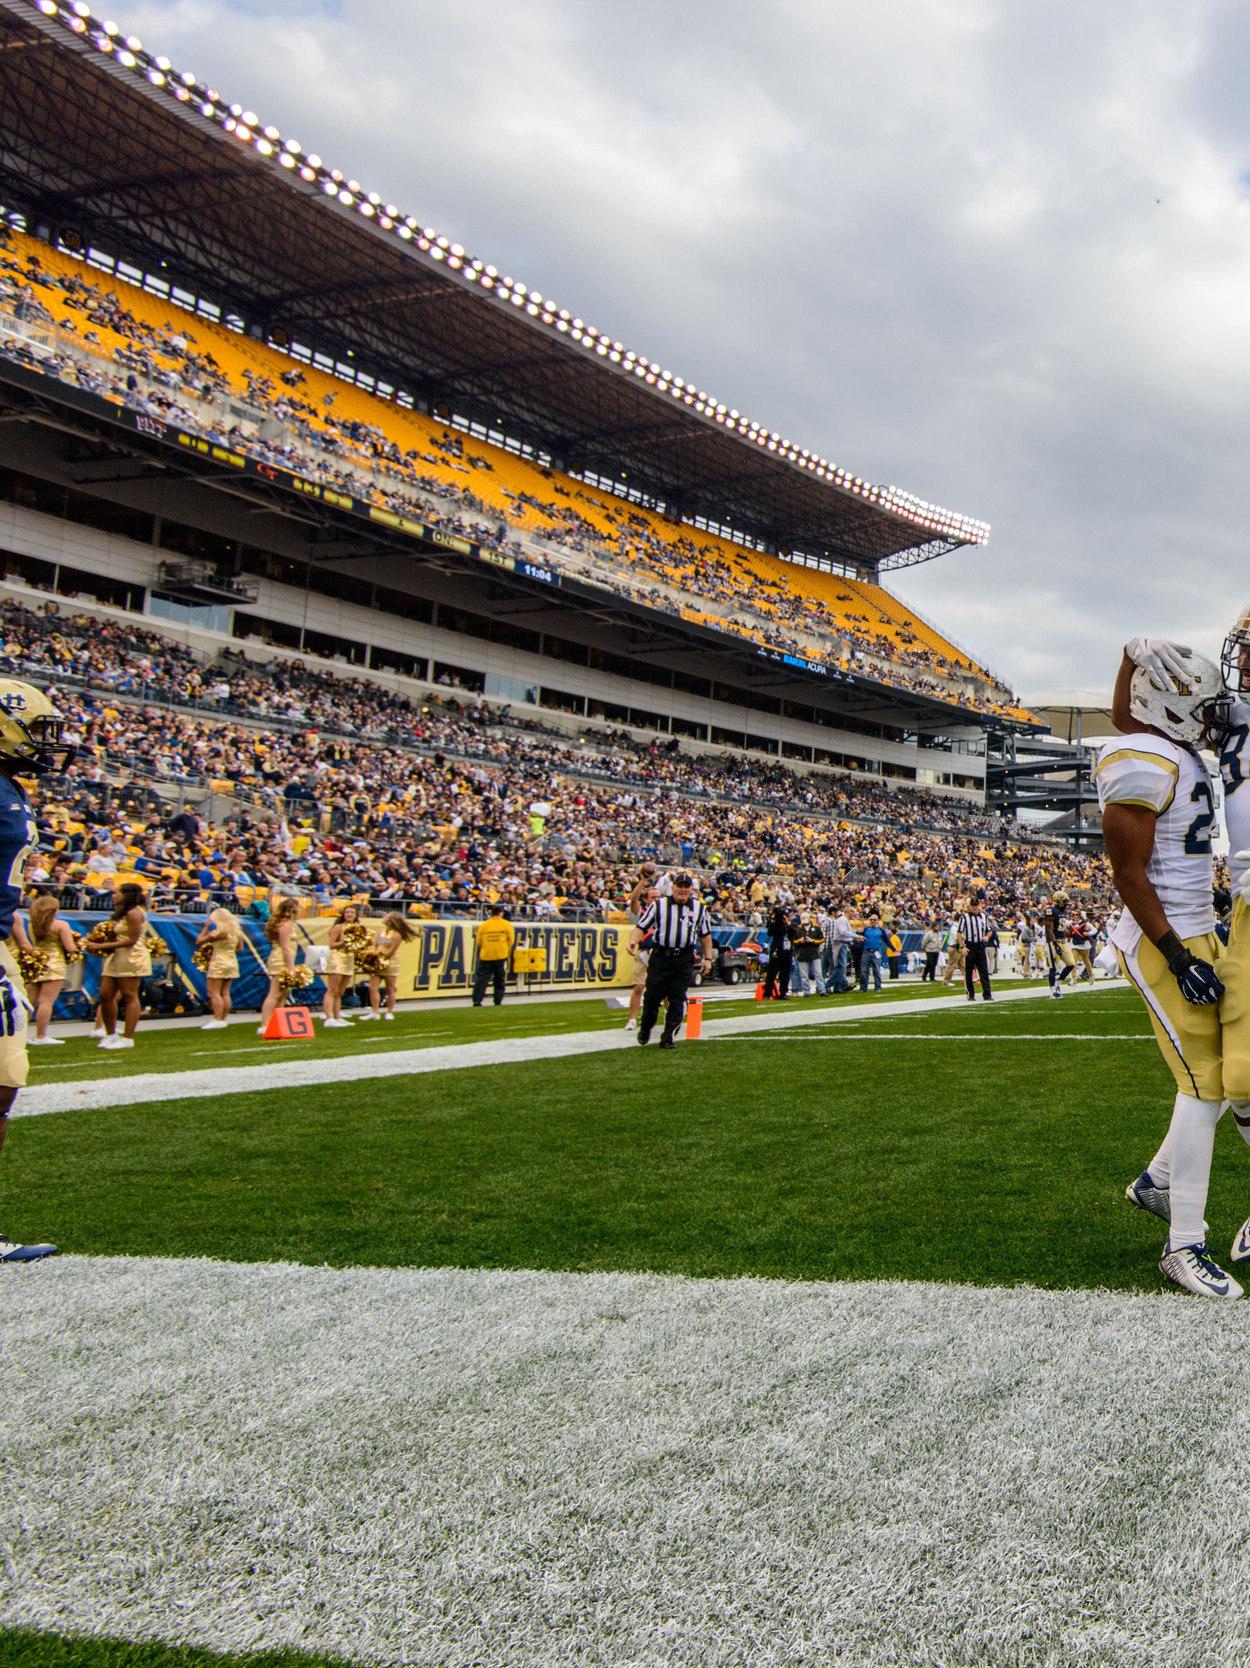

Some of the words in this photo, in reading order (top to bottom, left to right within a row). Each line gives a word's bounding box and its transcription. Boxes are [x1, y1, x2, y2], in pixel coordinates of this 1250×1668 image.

[487, 552, 508, 566] 1ST
[524, 564, 552, 582] 11:04
[806, 662, 827, 676] ACURA
[413, 924, 619, 991] PATHERS
[285, 1010, 308, 1035] G
